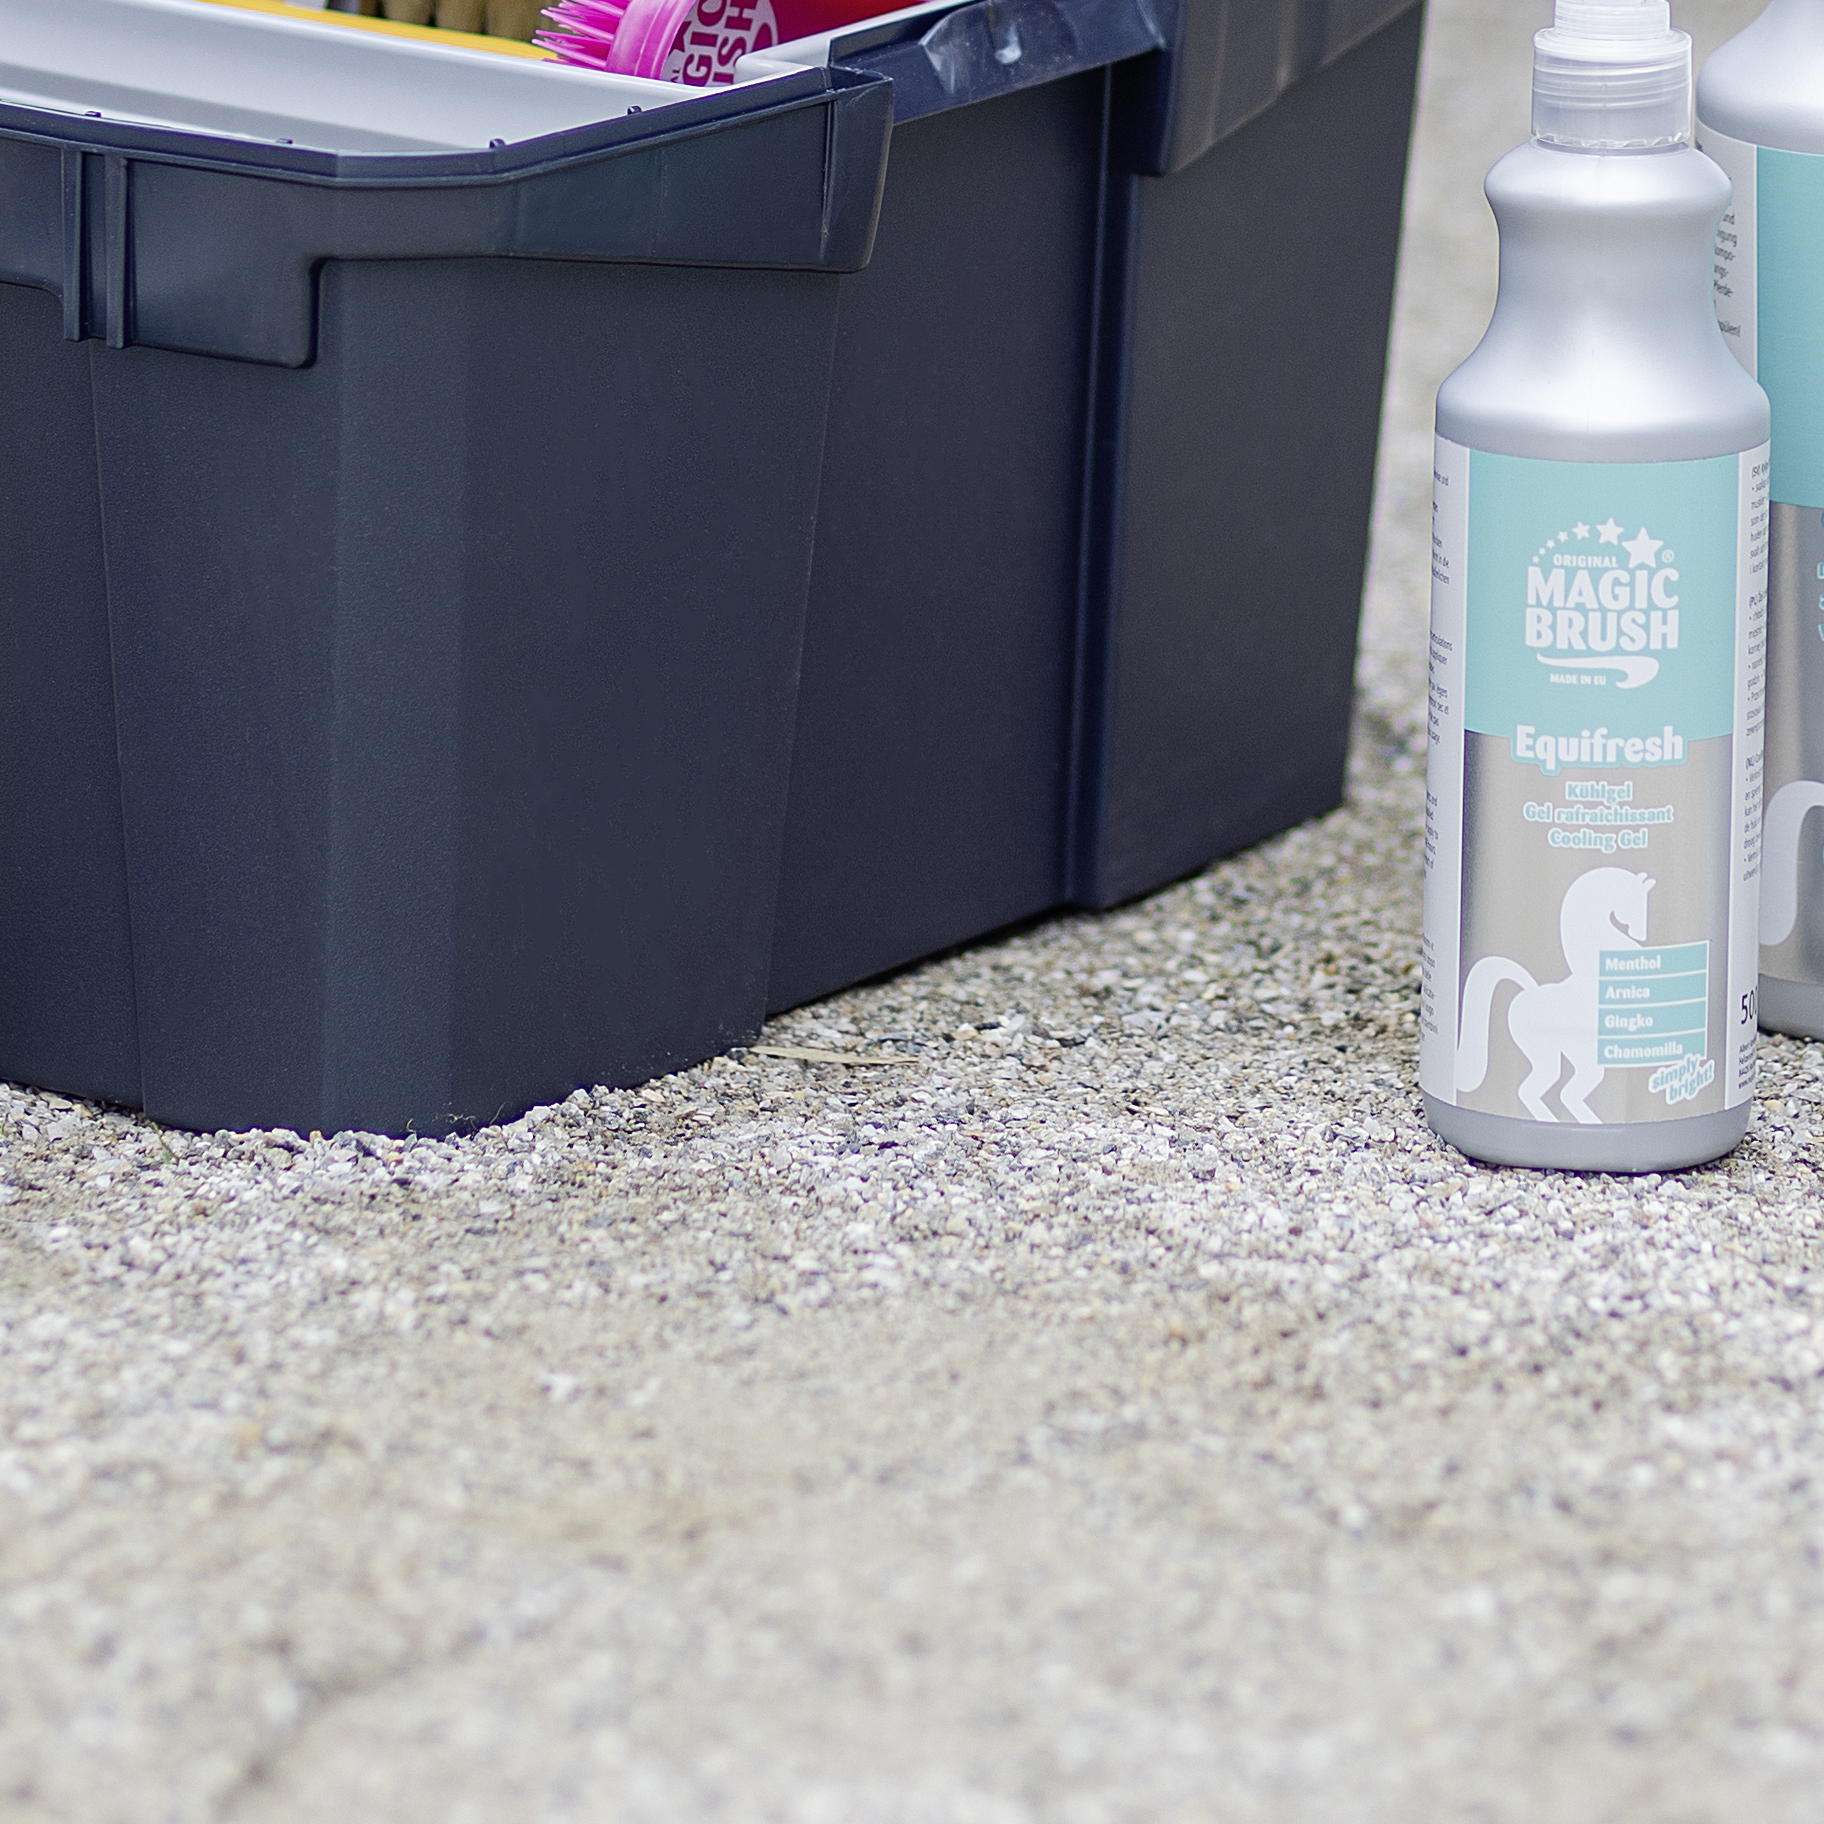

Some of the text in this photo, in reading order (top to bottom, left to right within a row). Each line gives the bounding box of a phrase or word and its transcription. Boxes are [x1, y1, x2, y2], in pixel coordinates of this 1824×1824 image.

[1553, 553, 1619, 568] ORIGINAL
[1527, 565, 1680, 610] MAGIC
[1525, 606, 1680, 652] BRUSH
[1550, 673, 1606, 686] MADE IN EU
[1516, 724, 1683, 770] Equifresh
[1566, 781, 1633, 805] Kühlgel
[1523, 802, 1674, 825] Gel rafraîchissant
[1548, 828, 1648, 853] Cooling Gel
[1605, 955, 1662, 972] Menthol
[1605, 985, 1650, 999] Arnica
[1604, 1014, 1654, 1031] Gingko
[1604, 1042, 1684, 1059] Chamomilla
[1651, 1055, 1699, 1091] simply
[1669, 1062, 1714, 1102] bright!
